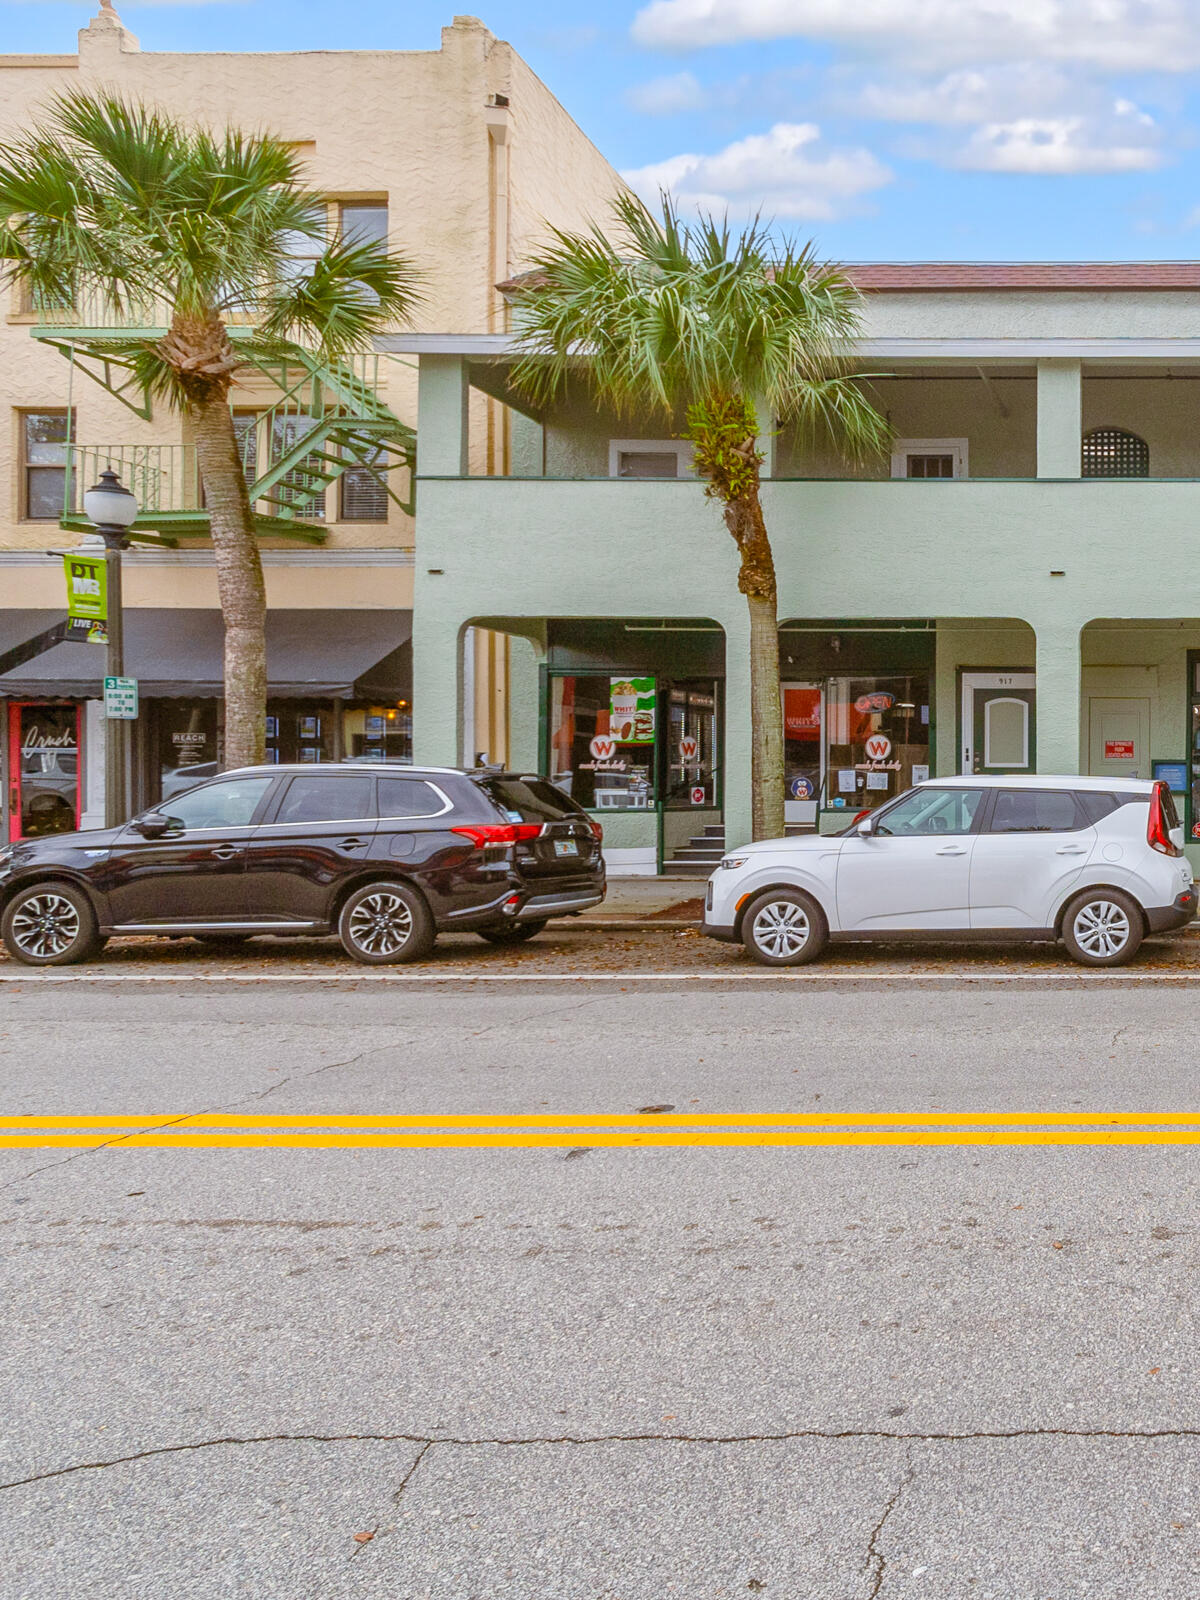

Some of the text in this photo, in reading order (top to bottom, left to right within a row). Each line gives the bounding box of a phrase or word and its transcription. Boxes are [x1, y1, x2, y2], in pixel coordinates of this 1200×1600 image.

[71, 562, 99, 580] DT
[73, 618, 92, 629] LIVE
[107, 679, 116, 689] 3
[856, 695, 892, 709] OPEN
[593, 741, 613, 756] W
[680, 742, 697, 756] W
[869, 741, 888, 756] W
